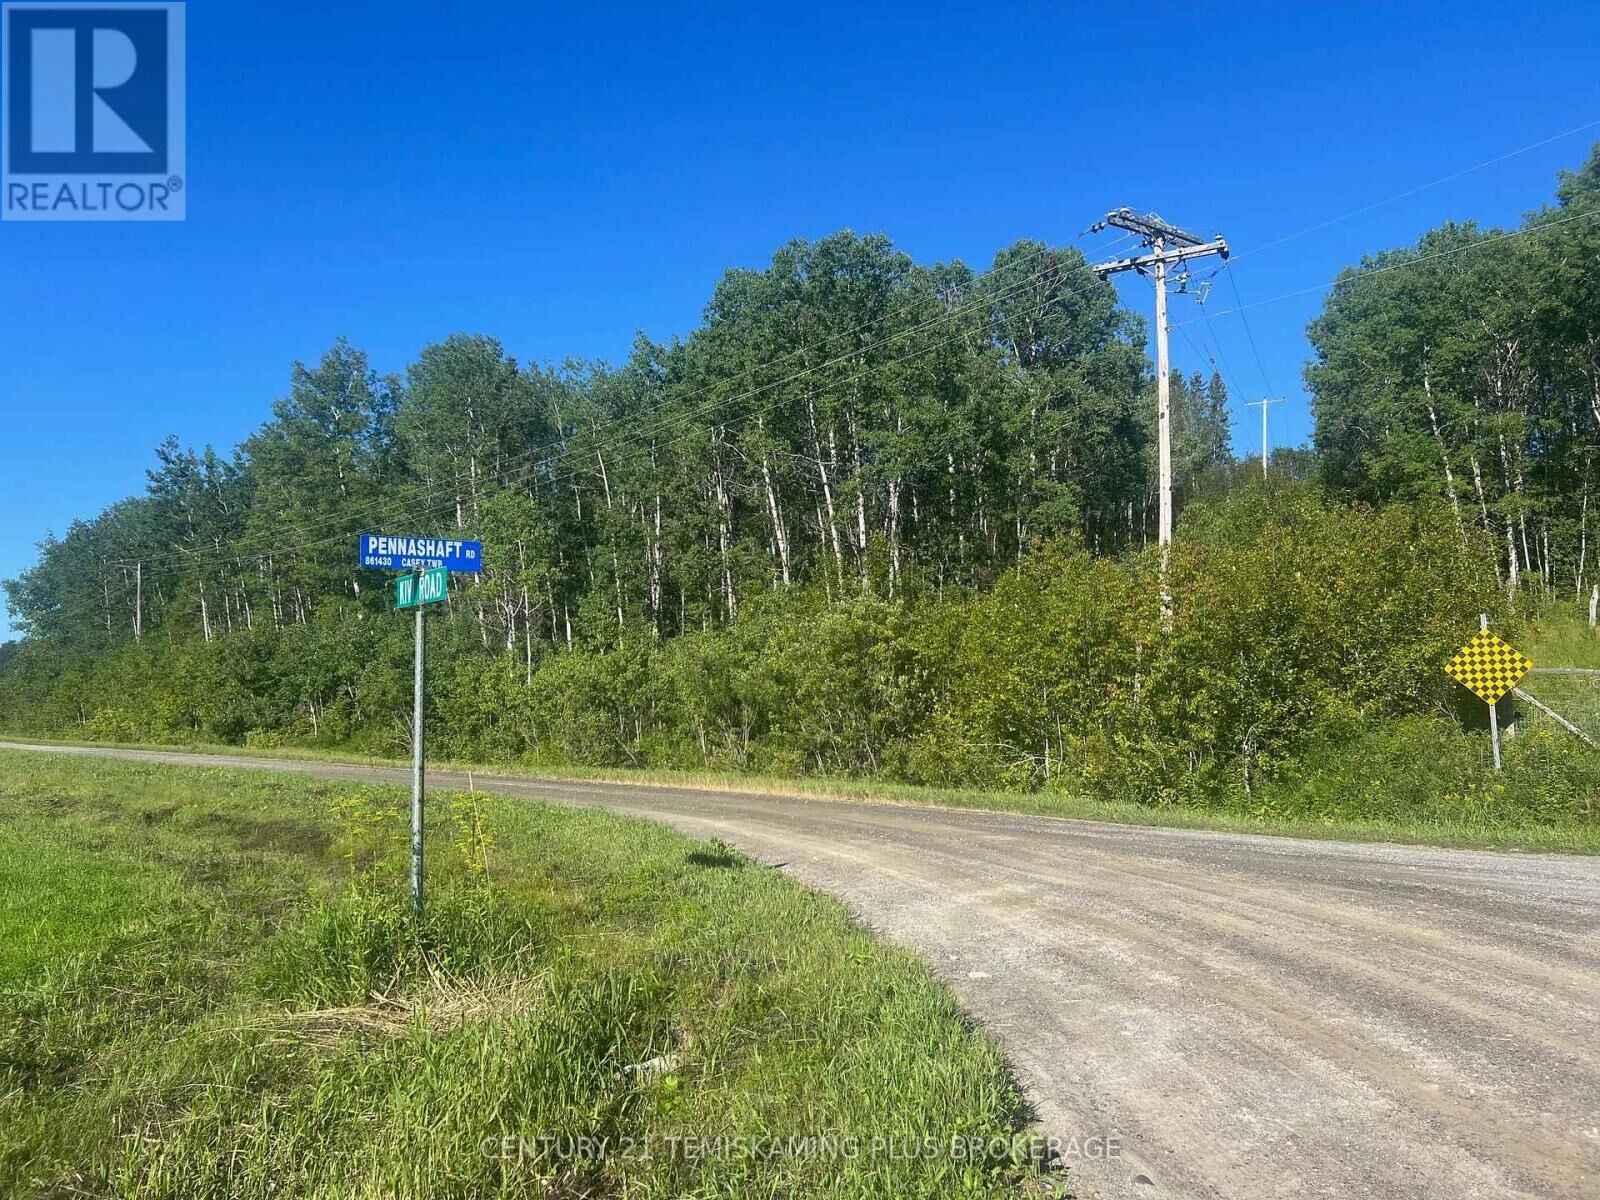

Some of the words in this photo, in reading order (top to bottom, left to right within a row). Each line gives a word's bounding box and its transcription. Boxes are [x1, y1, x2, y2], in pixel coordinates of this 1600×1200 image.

[368, 536, 462, 558] PENNASHAFT
[465, 550, 476, 559] RD
[365, 556, 392, 566] 861430
[401, 558, 425, 568] CASEY
[427, 559, 443, 568] TWP
[418, 572, 442, 601] ROAD
